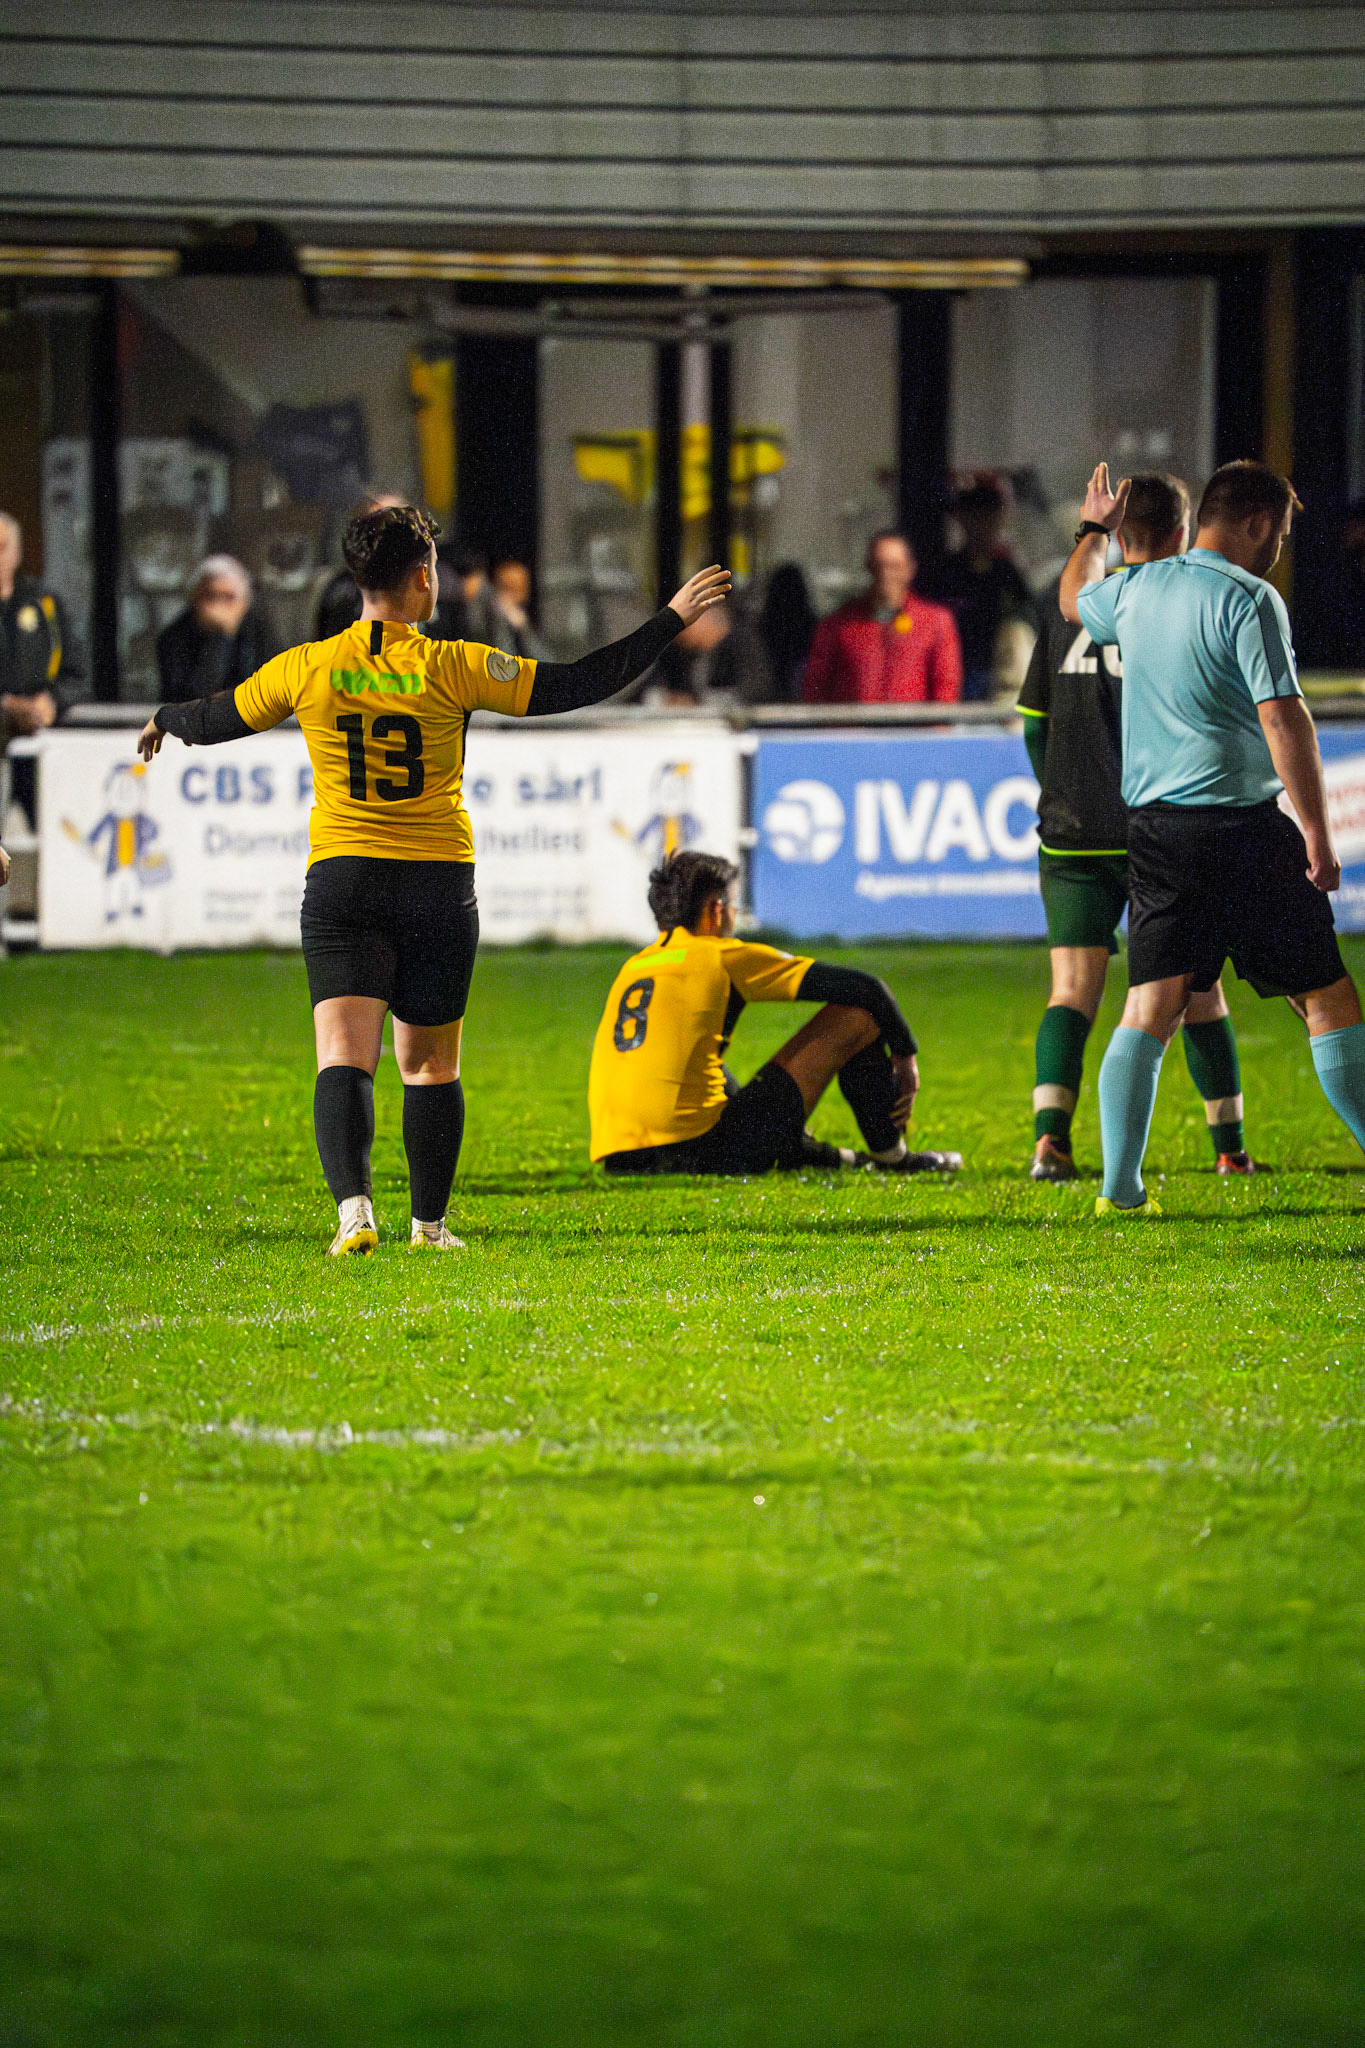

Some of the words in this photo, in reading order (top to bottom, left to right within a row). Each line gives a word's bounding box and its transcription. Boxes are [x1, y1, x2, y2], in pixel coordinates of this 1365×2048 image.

[180, 764, 273, 804] CBS
[336, 713, 425, 802] 13
[613, 977, 655, 1053] 8
